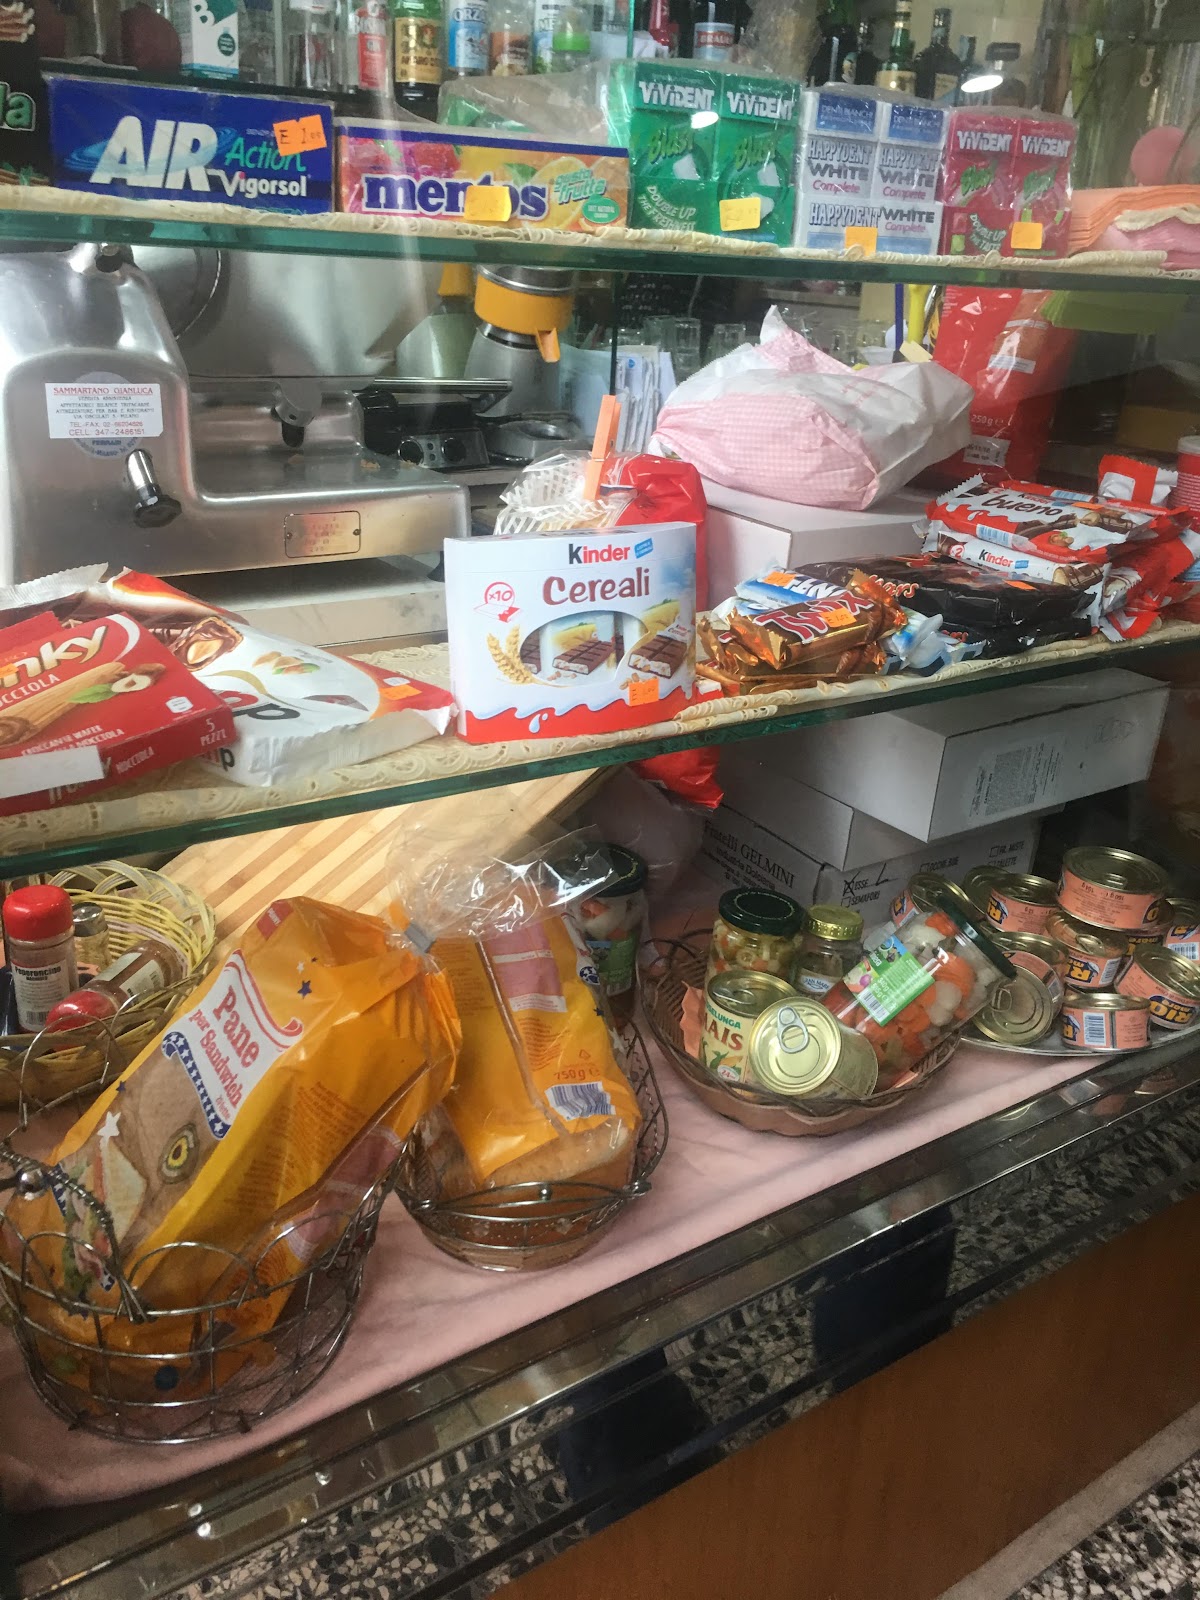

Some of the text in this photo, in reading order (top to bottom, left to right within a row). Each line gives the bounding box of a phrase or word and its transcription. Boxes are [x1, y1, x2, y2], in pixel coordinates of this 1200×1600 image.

[89, 115, 219, 192] AIR
[808, 140, 873, 165] HAPPYDENT
[879, 147, 939, 172] HAPPYDENT
[210, 169, 308, 198] Vigorsol
[812, 180, 861, 195] Complete
[647, 185, 678, 218] DOUBLE
[679, 206, 697, 219] UP
[809, 203, 881, 228] HAPPYDENT
[885, 222, 926, 233] Complete
[54, 387, 109, 395] SAMMARTANO
[982, 494, 1063, 518] bueno
[568, 543, 631, 565] Kinder
[979, 549, 1013, 568] Kinder
[542, 566, 650, 606] Cereali
[205, 718, 216, 732] 5
[740, 844, 795, 889] GELMINI
[1149, 1001, 1192, 1023] RIO
[212, 984, 260, 1068] Pane
[189, 1009, 211, 1032] per
[200, 1029, 243, 1109] Sandwich
